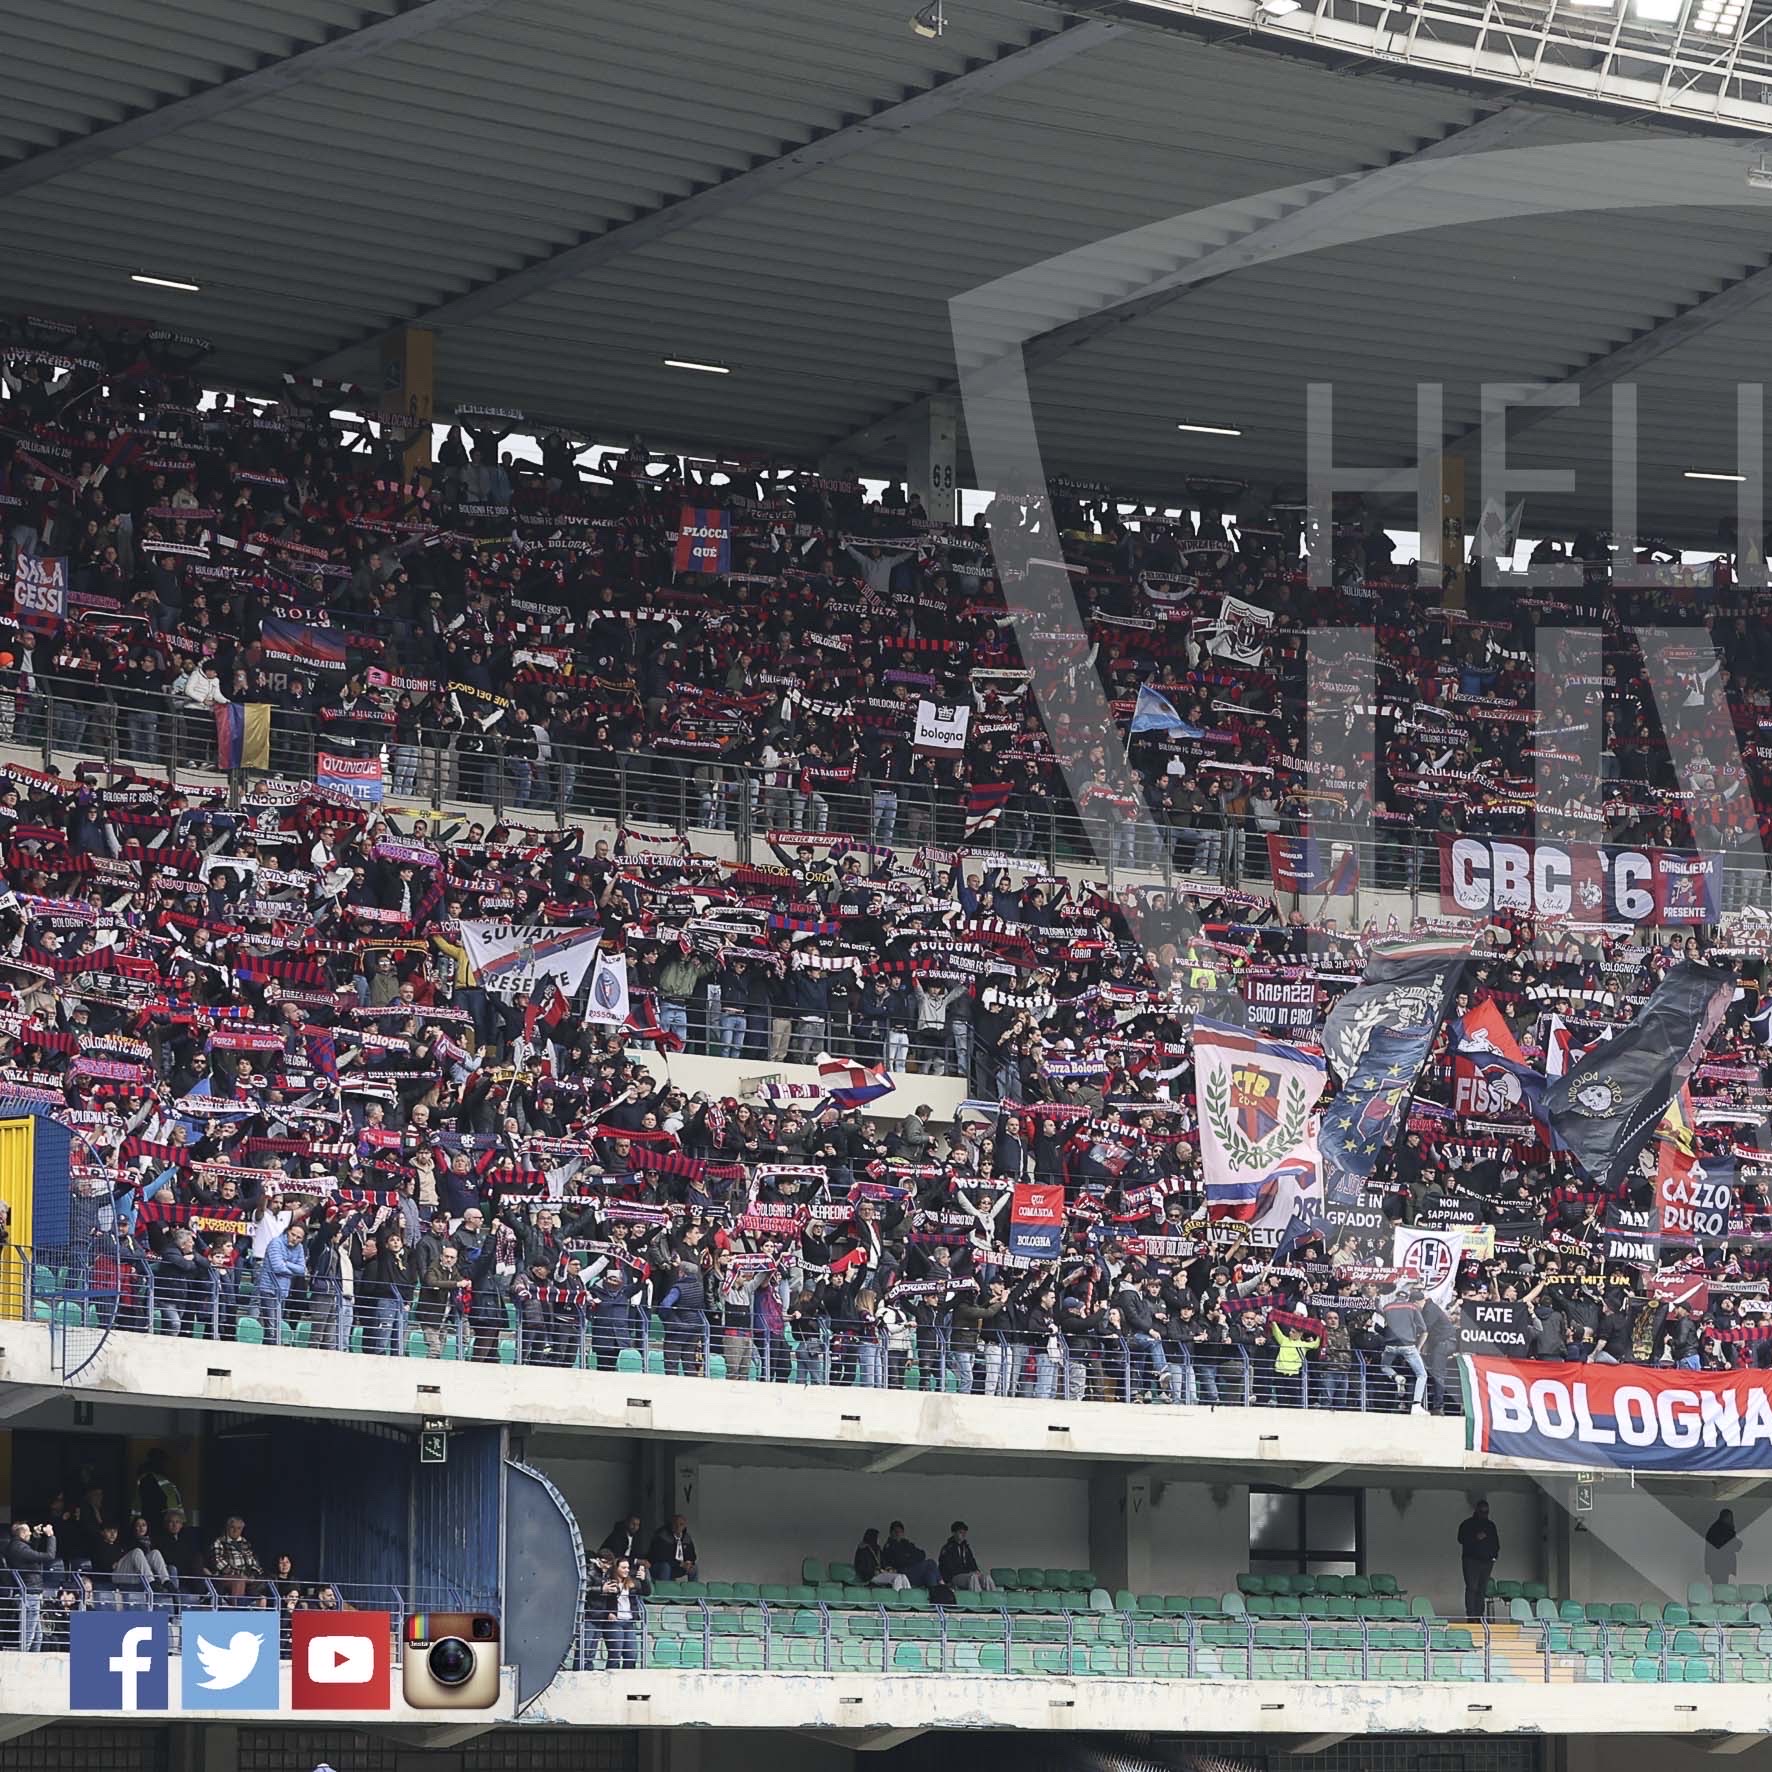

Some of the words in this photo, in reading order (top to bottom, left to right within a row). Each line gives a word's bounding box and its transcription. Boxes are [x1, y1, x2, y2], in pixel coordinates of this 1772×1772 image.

[933, 464, 952, 489] 68
[682, 525, 728, 539] PLÓCCA
[692, 544, 718, 558] QUÉ
[16, 551, 64, 587] SALA
[14, 583, 63, 615] GESSI
[265, 650, 293, 663] TORRE
[303, 656, 347, 670] MARATONA
[391, 677, 428, 691] BOLOGNA
[920, 724, 964, 742] bologna
[323, 758, 377, 775] OVUNQUE
[1281, 755, 1313, 774] BOLOGNA
[1658, 859, 1714, 875] GHISILIERA
[1452, 839, 1572, 914] CBC
[857, 879, 884, 891] Bologna
[839, 904, 859, 915] FORIA
[1663, 905, 1706, 918] PRESENTE
[1039, 926, 1066, 937] BOLOGNA
[920, 941, 980, 954] BOLOGNA
[1070, 948, 1092, 959] FORIA
[1247, 981, 1254, 999] I
[1256, 981, 1315, 1002] RAGAZZI
[1247, 1006, 1275, 1025] SONO
[1277, 1007, 1287, 1025] IN
[1290, 1007, 1313, 1026] GIRO
[1163, 1043, 1185, 1056] FORIA
[554, 1080, 580, 1091] 1909
[1455, 1077, 1505, 1113] FISS
[1687, 1158, 1708, 1181] A
[501, 1195, 543, 1207] JUVE
[545, 1195, 598, 1207] MERDA
[1031, 1194, 1044, 1206] QUI
[1367, 1194, 1383, 1208] IN
[1662, 1179, 1730, 1210] CAZZO
[1439, 1197, 1459, 1209] NON
[808, 1205, 852, 1220] WEAREONE
[1018, 1206, 1054, 1218] COMANDA
[1427, 1208, 1474, 1221] SAPPIAMO
[1618, 1208, 1649, 1228] MAI
[1326, 1212, 1382, 1228] GRADO?
[1662, 1207, 1724, 1237] DURO
[1016, 1235, 1051, 1248] BOLOGNA
[1609, 1240, 1655, 1262] DOMI
[1580, 1275, 1601, 1285] MIT
[1475, 1306, 1513, 1323] FATE
[1460, 1329, 1525, 1345] QUALCOSA
